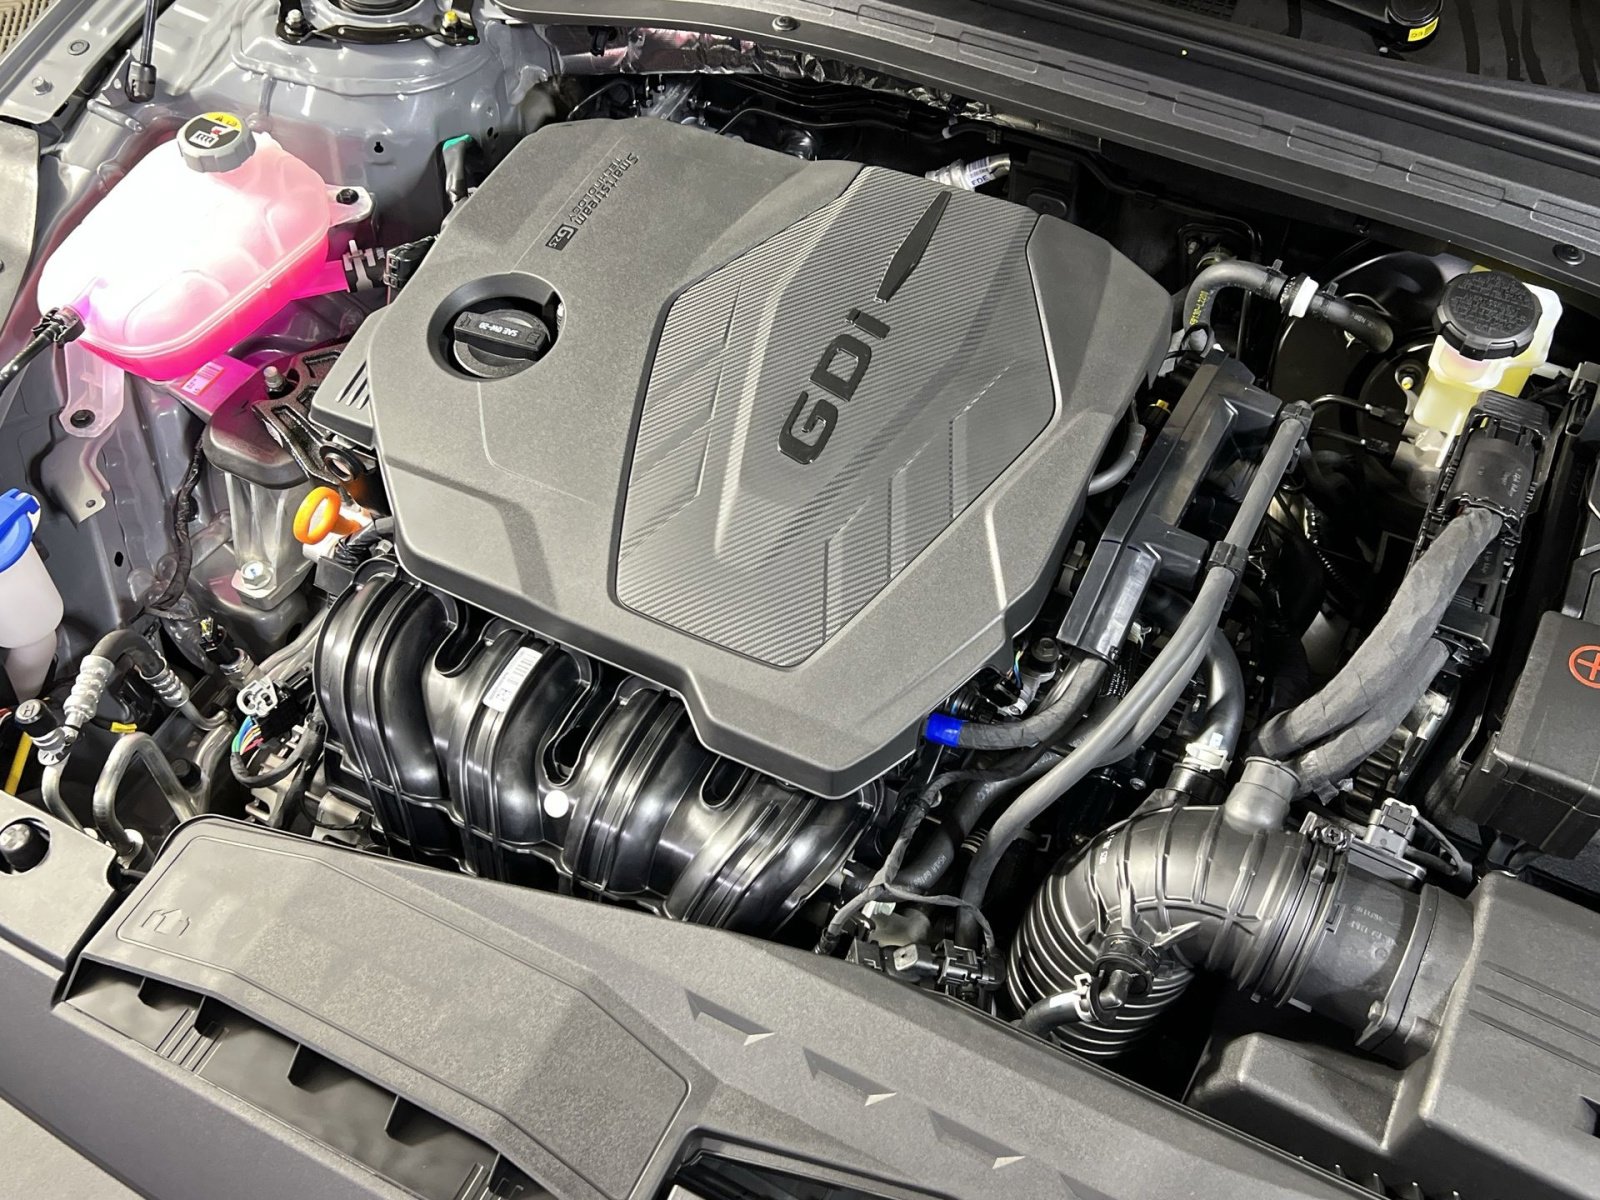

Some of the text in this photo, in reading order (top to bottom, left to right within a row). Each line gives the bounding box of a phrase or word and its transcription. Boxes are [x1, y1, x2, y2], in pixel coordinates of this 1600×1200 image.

[568, 158, 623, 222] TECHNOLOGY
[574, 152, 639, 226] Smartstream
[501, 327, 519, 337] SAE
